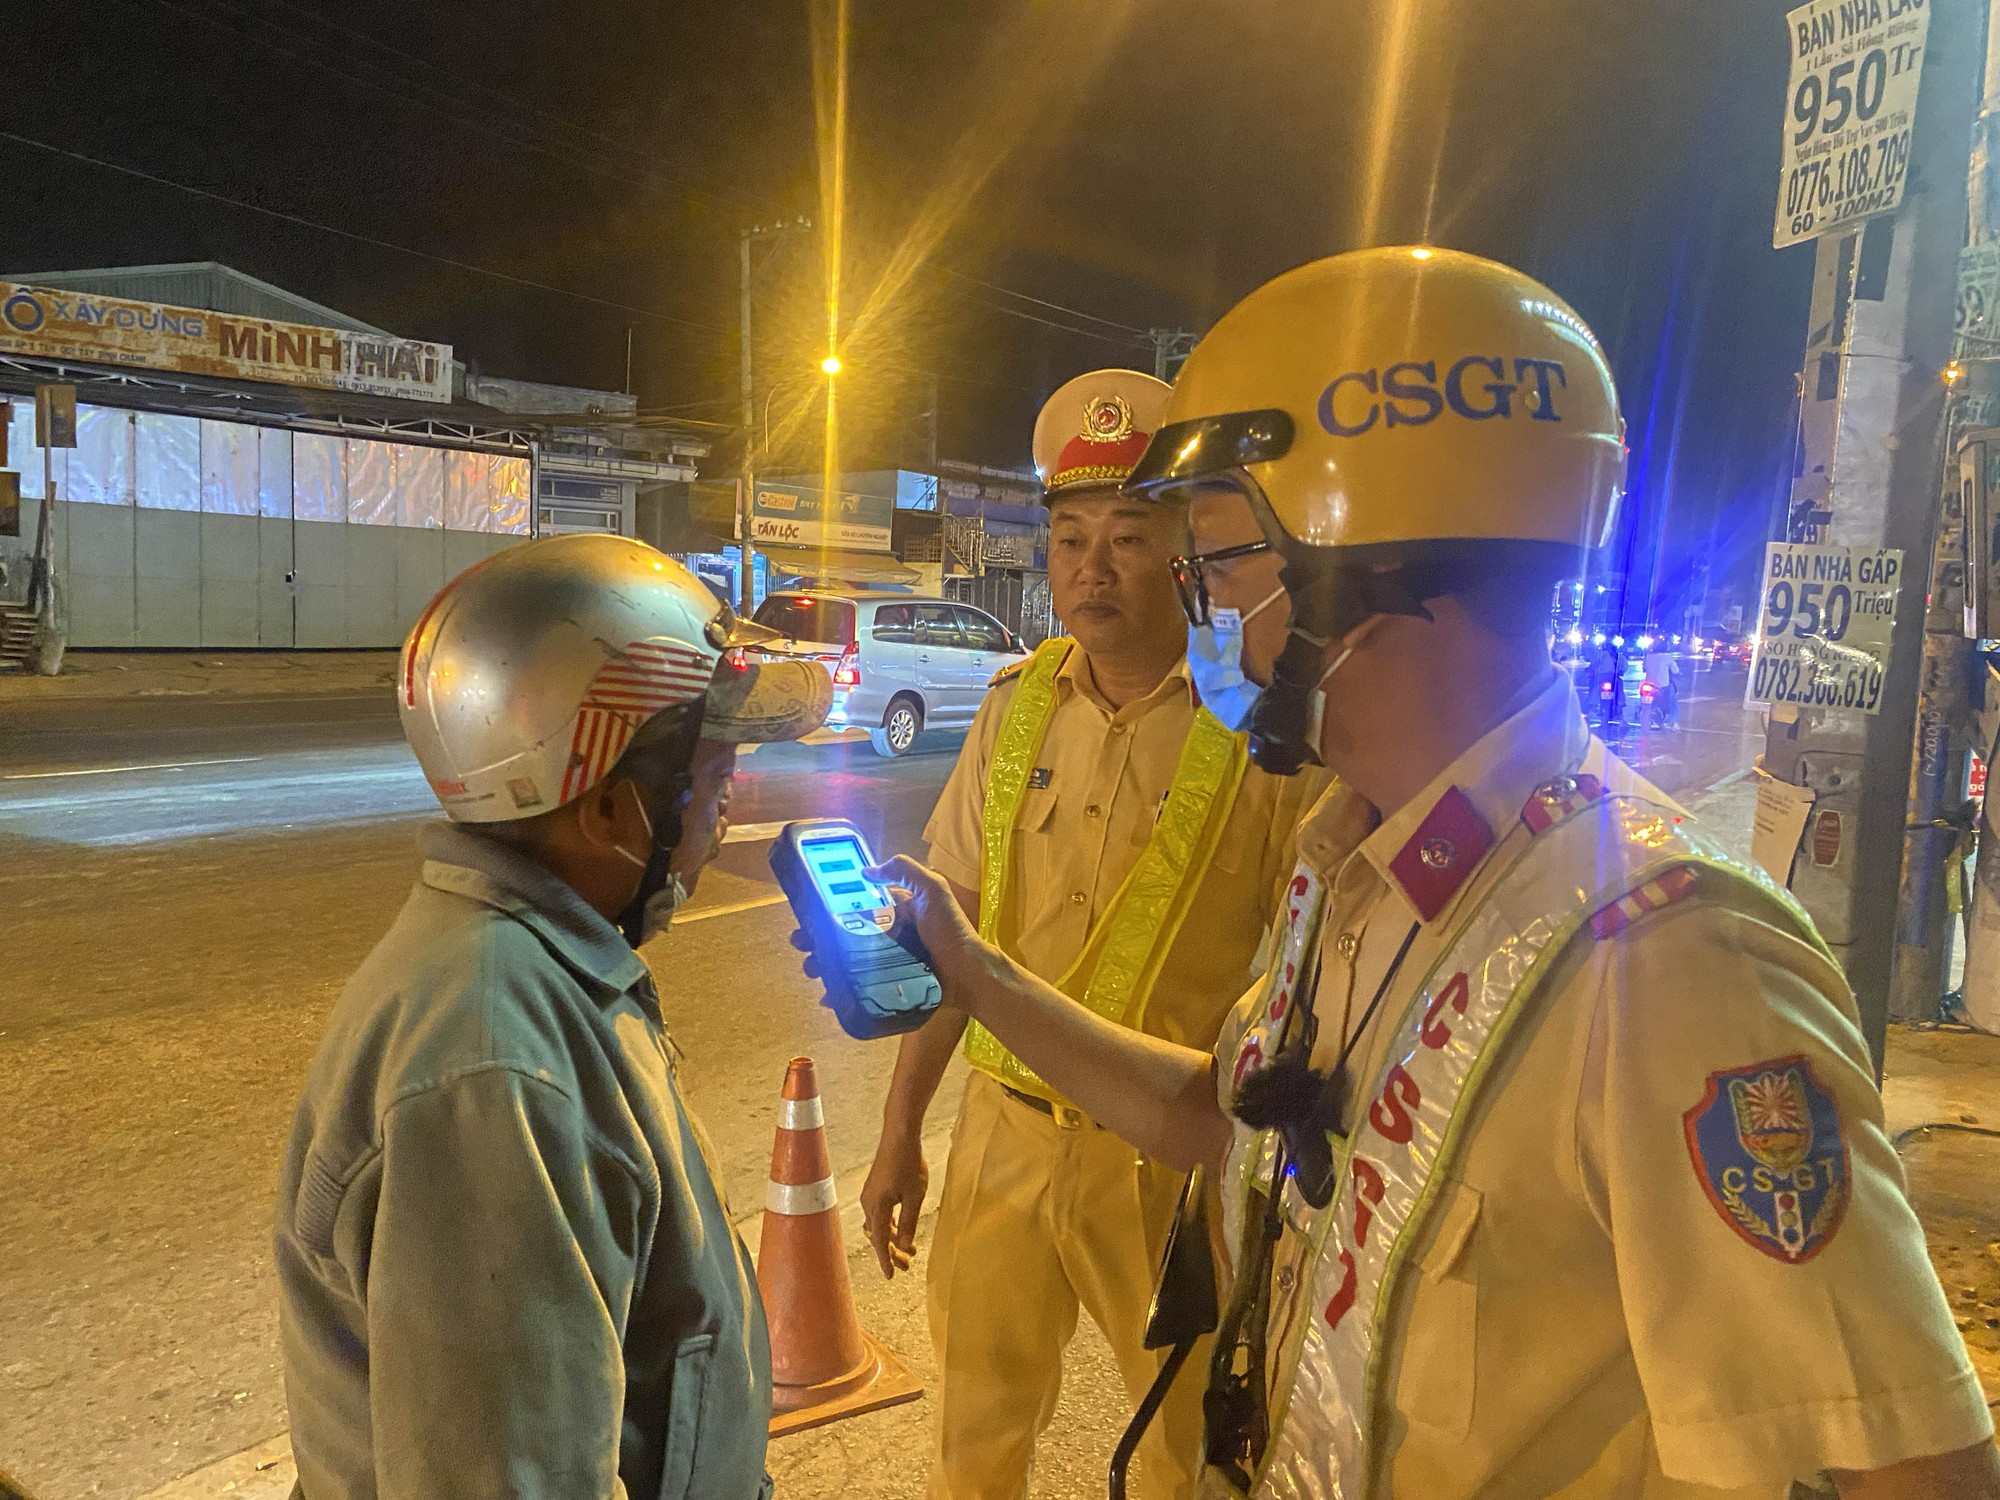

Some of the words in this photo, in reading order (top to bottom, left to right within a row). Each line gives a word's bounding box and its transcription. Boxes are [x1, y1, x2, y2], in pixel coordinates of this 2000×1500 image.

[1798, 6, 1835, 58] BÁN
[1794, 49, 1886, 146] 950
[1891, 41, 1921, 76] Tr
[1791, 212, 1814, 236] 60
[1833, 186, 1896, 222] 100M2
[53, 298, 107, 324] XÂY
[1317, 356, 1566, 437] CSGT
[1771, 545, 1808, 579] BÁN
[1813, 550, 1852, 582] NHÀ
[1858, 550, 1897, 585] GẤP
[1766, 581, 1851, 641] 950
[1722, 1158, 1834, 1193] CSGT
